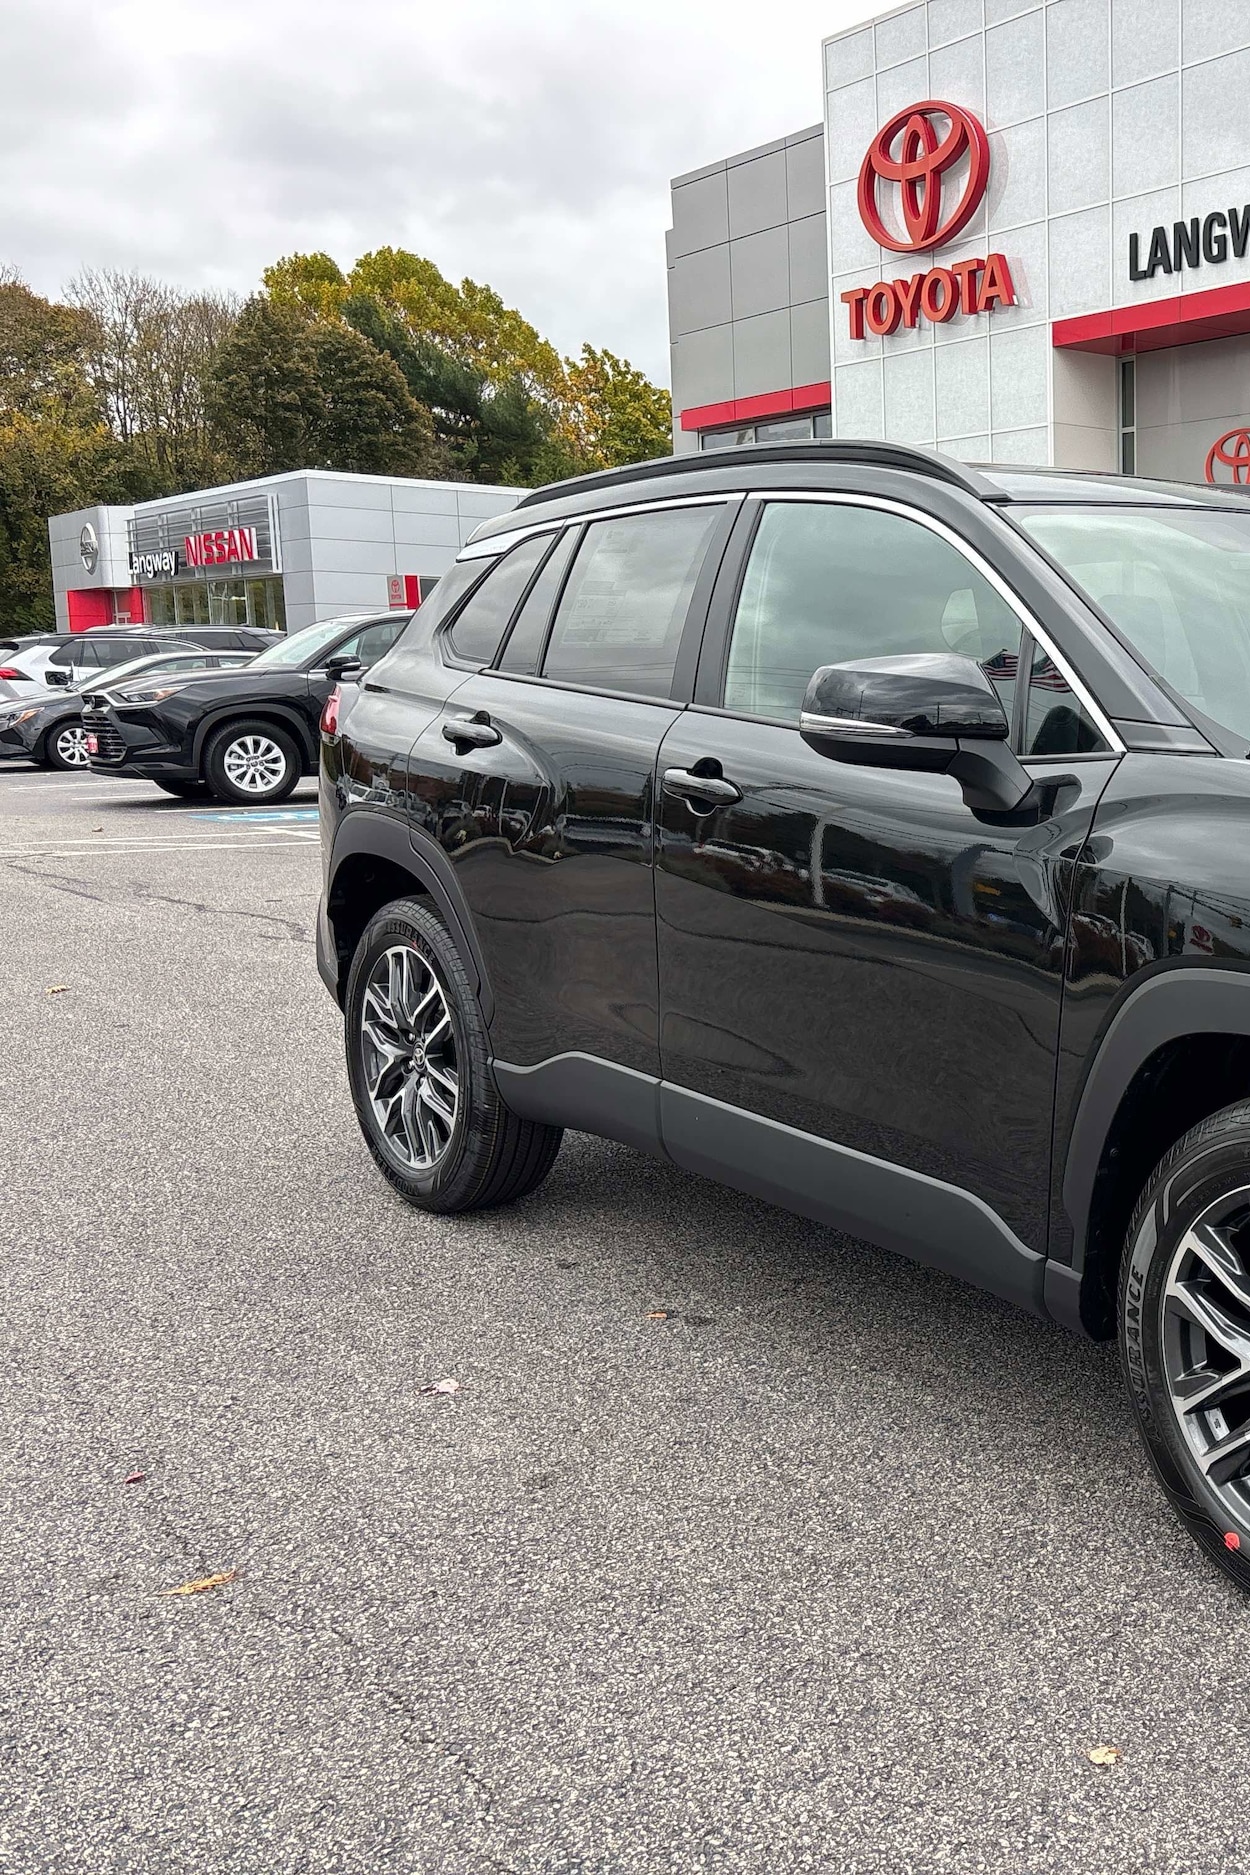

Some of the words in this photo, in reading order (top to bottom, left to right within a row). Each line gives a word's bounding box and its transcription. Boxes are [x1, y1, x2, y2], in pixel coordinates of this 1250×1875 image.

[841, 253, 1018, 340] TOYOTA
[128, 551, 178, 578] Langway
[185, 527, 257, 567] NISSAN
[1127, 1265, 1162, 1443] ASSURANCE
